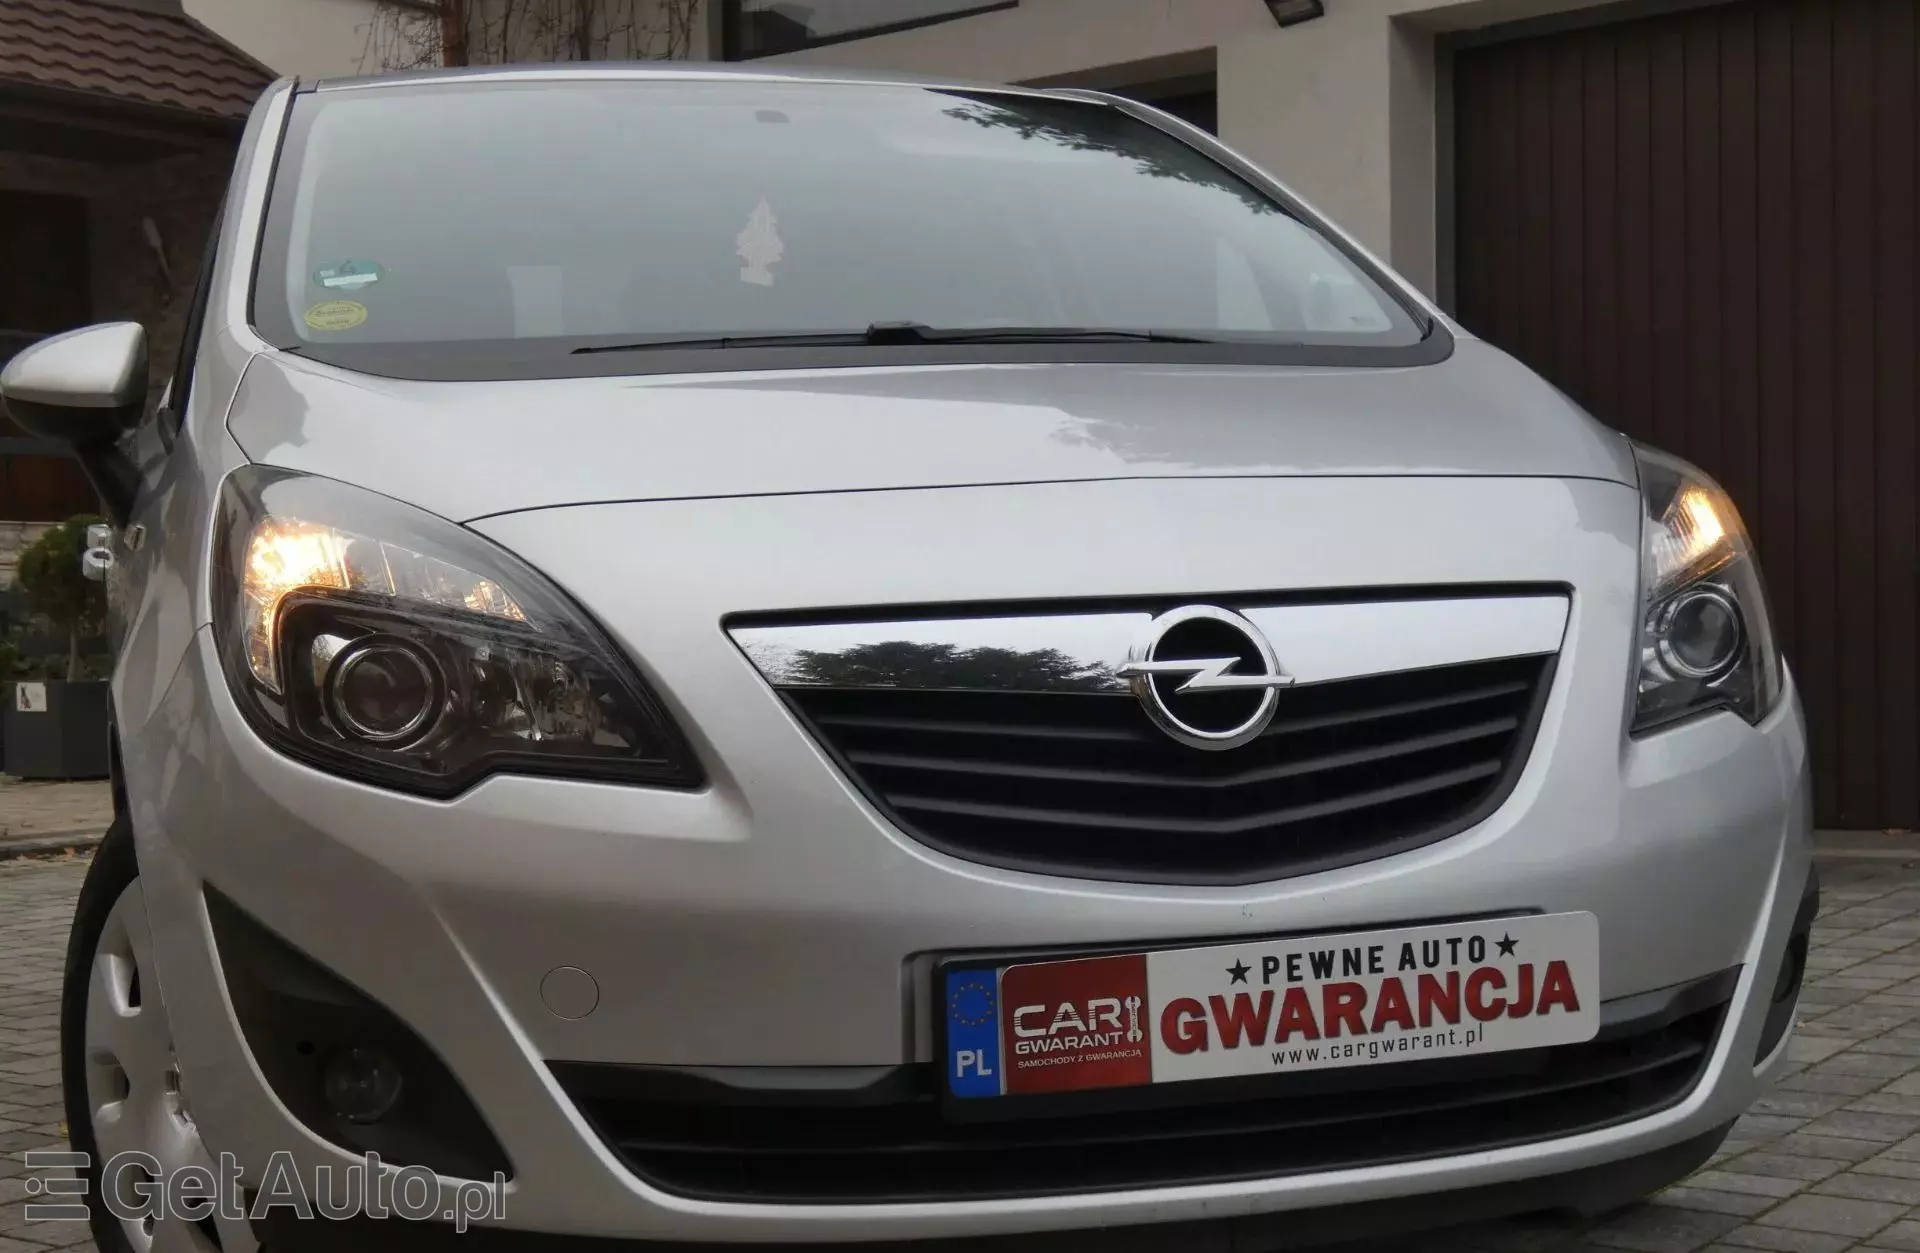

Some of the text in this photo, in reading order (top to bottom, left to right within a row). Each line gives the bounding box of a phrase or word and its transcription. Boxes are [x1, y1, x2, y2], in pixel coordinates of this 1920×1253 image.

[1262, 935, 1485, 984] PEWNE AUTO
[1013, 997, 1123, 1038] CAR
[1160, 960, 1581, 1055] GWARANCJA
[956, 1049, 992, 1077] PL
[1015, 1031, 1123, 1055] GWARANT
[1018, 1055, 1076, 1069] SAMOCHODY
[1078, 1055, 1084, 1063] Z
[1271, 1022, 1484, 1065] www.cargwarant.pl
